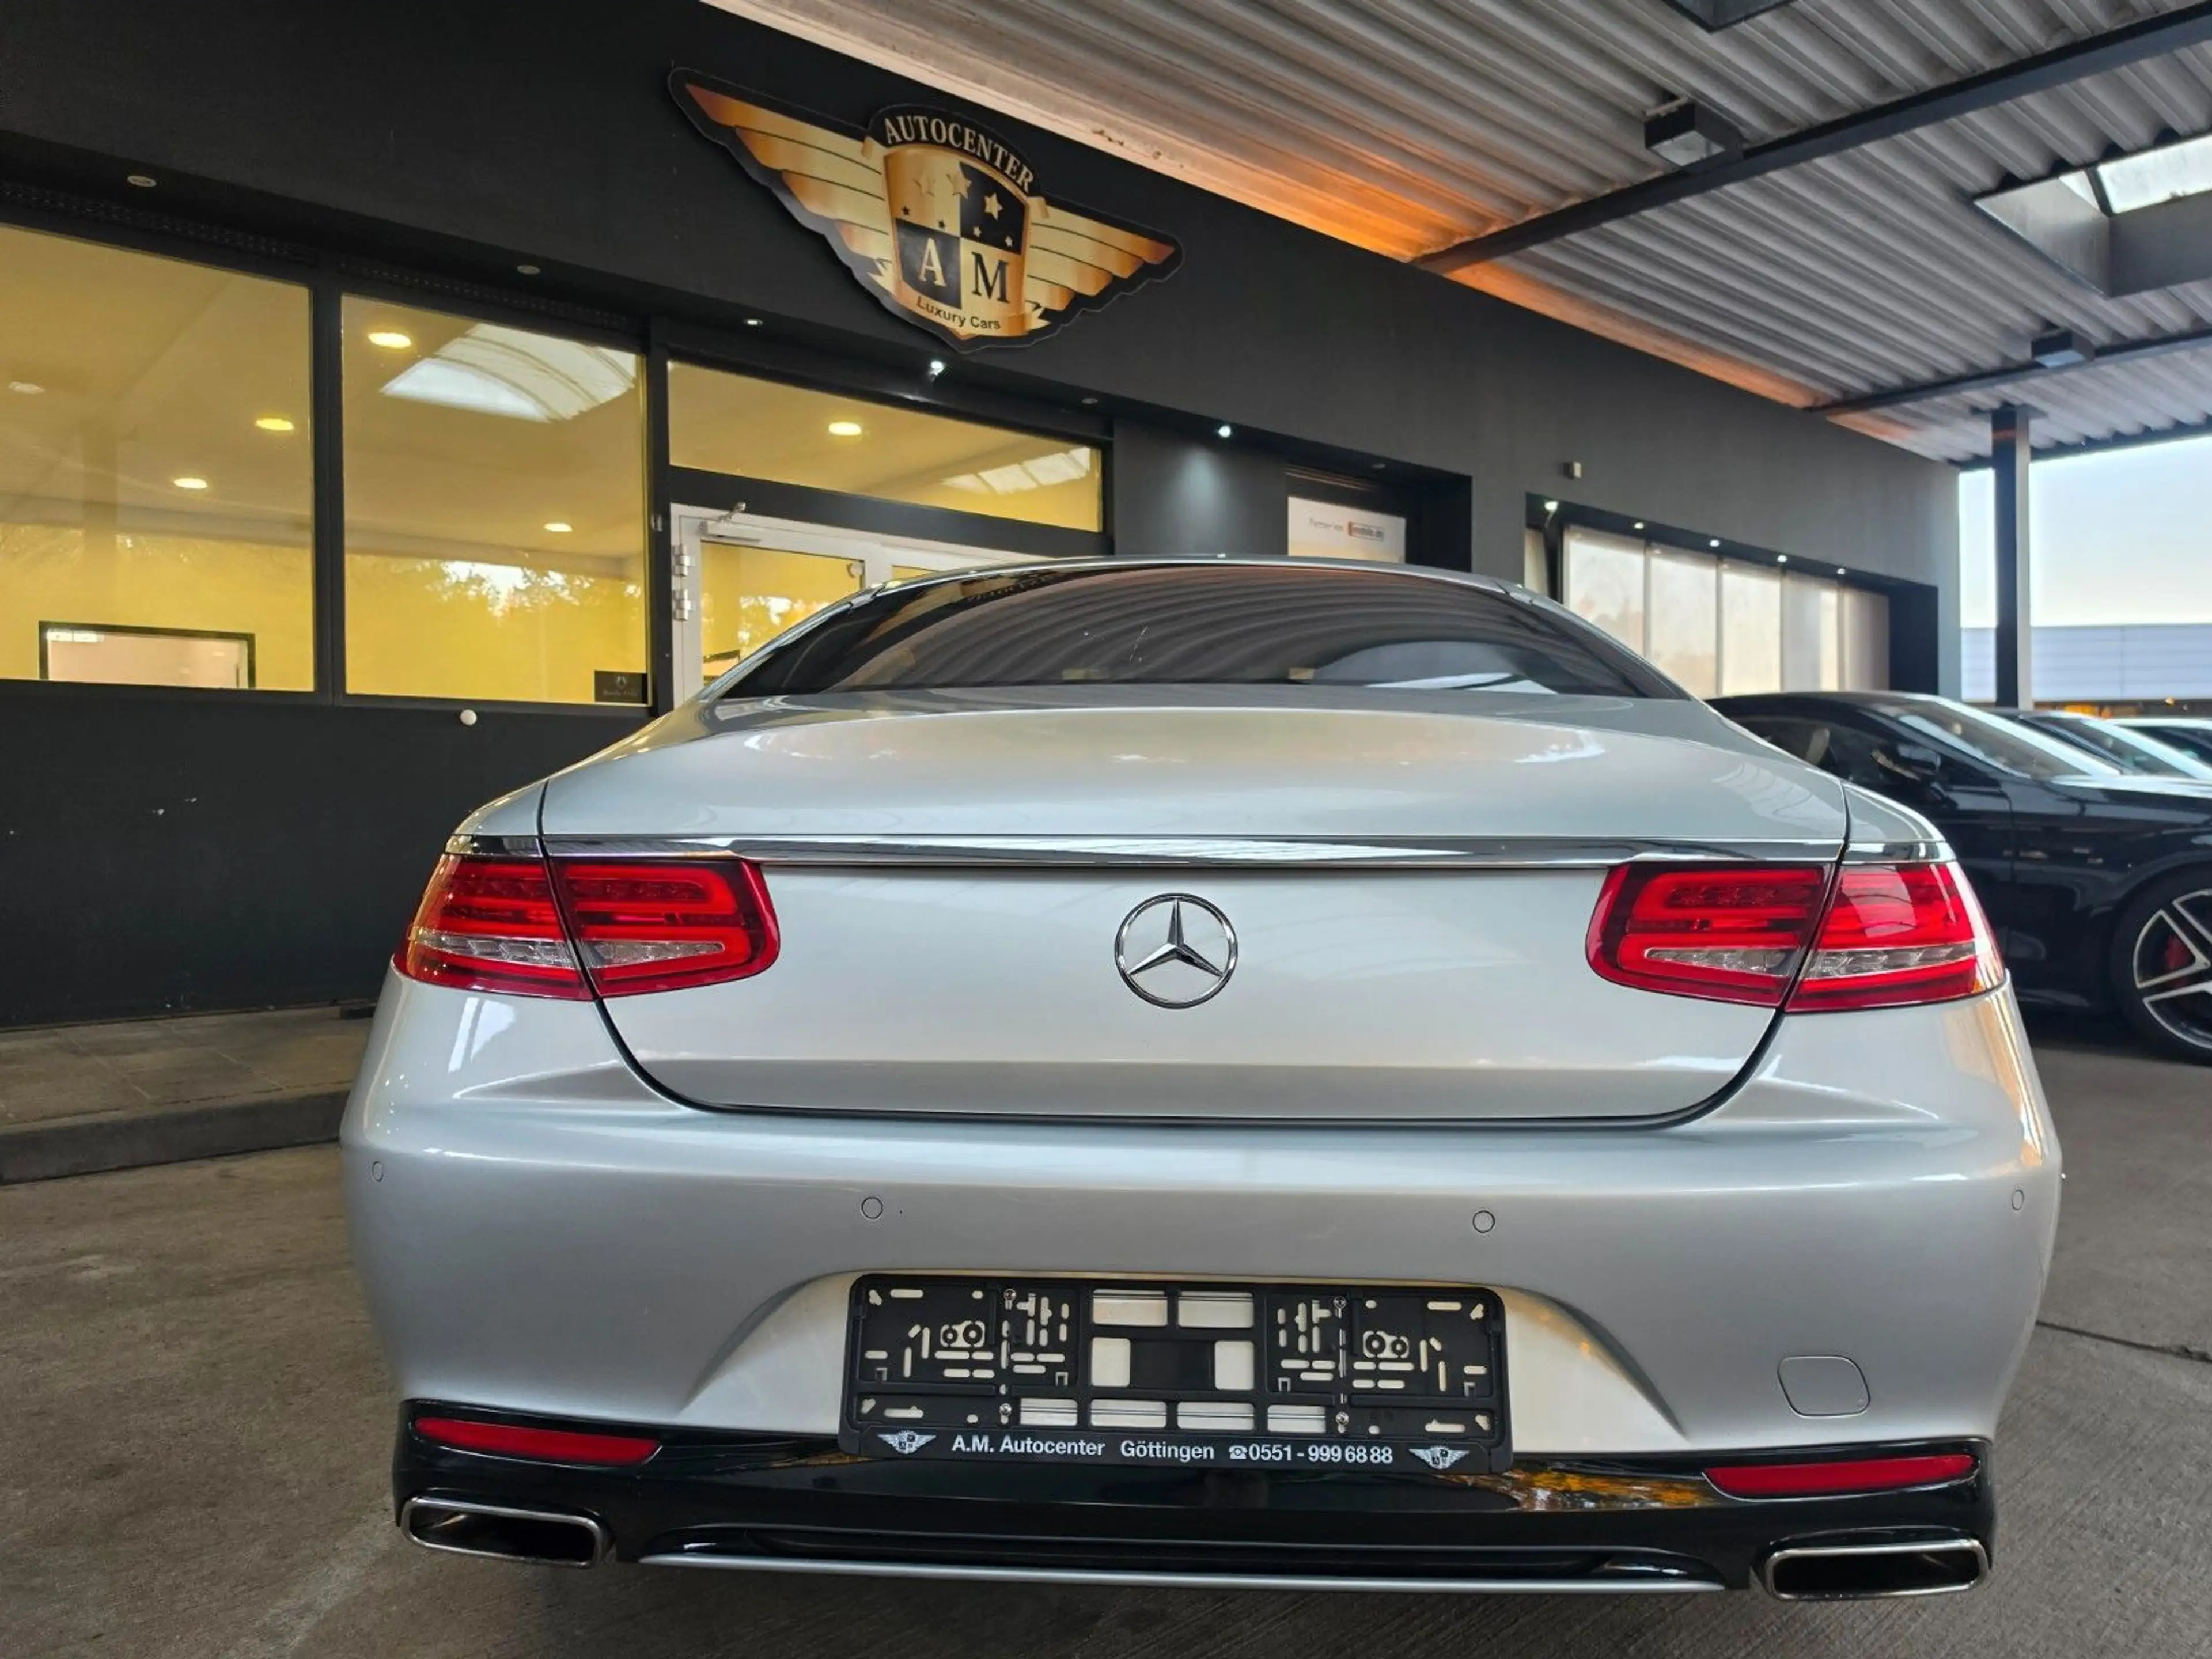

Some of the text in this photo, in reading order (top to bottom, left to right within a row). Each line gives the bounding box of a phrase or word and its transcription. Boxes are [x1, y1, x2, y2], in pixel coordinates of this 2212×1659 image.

[884, 115, 1034, 193] AUTOCENTER
[919, 237, 1009, 304] A M
[916, 296, 1001, 330] Luxury Cars
[951, 1434, 995, 1453] A.M.
[999, 1435, 1105, 1456] Autocenter
[1120, 1440, 1214, 1463] Göttingen
